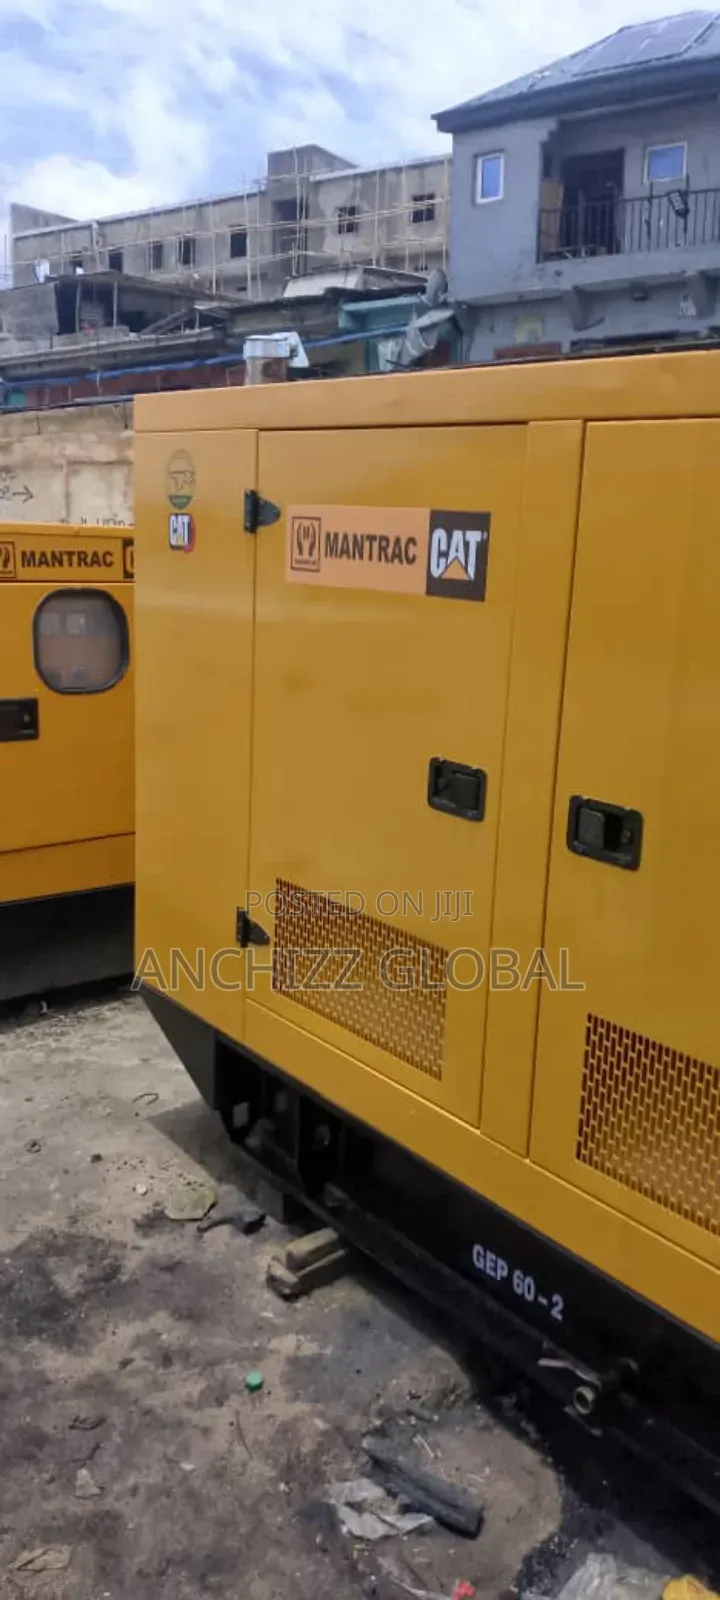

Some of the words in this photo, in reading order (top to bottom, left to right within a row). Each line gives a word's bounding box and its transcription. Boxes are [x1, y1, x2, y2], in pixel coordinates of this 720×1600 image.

[170, 514, 190, 546] CAT
[21, 550, 114, 569] MANTRAC
[324, 532, 417, 566] MANTRAC
[430, 528, 485, 582] CAT
[472, 1243, 508, 1281] GEP
